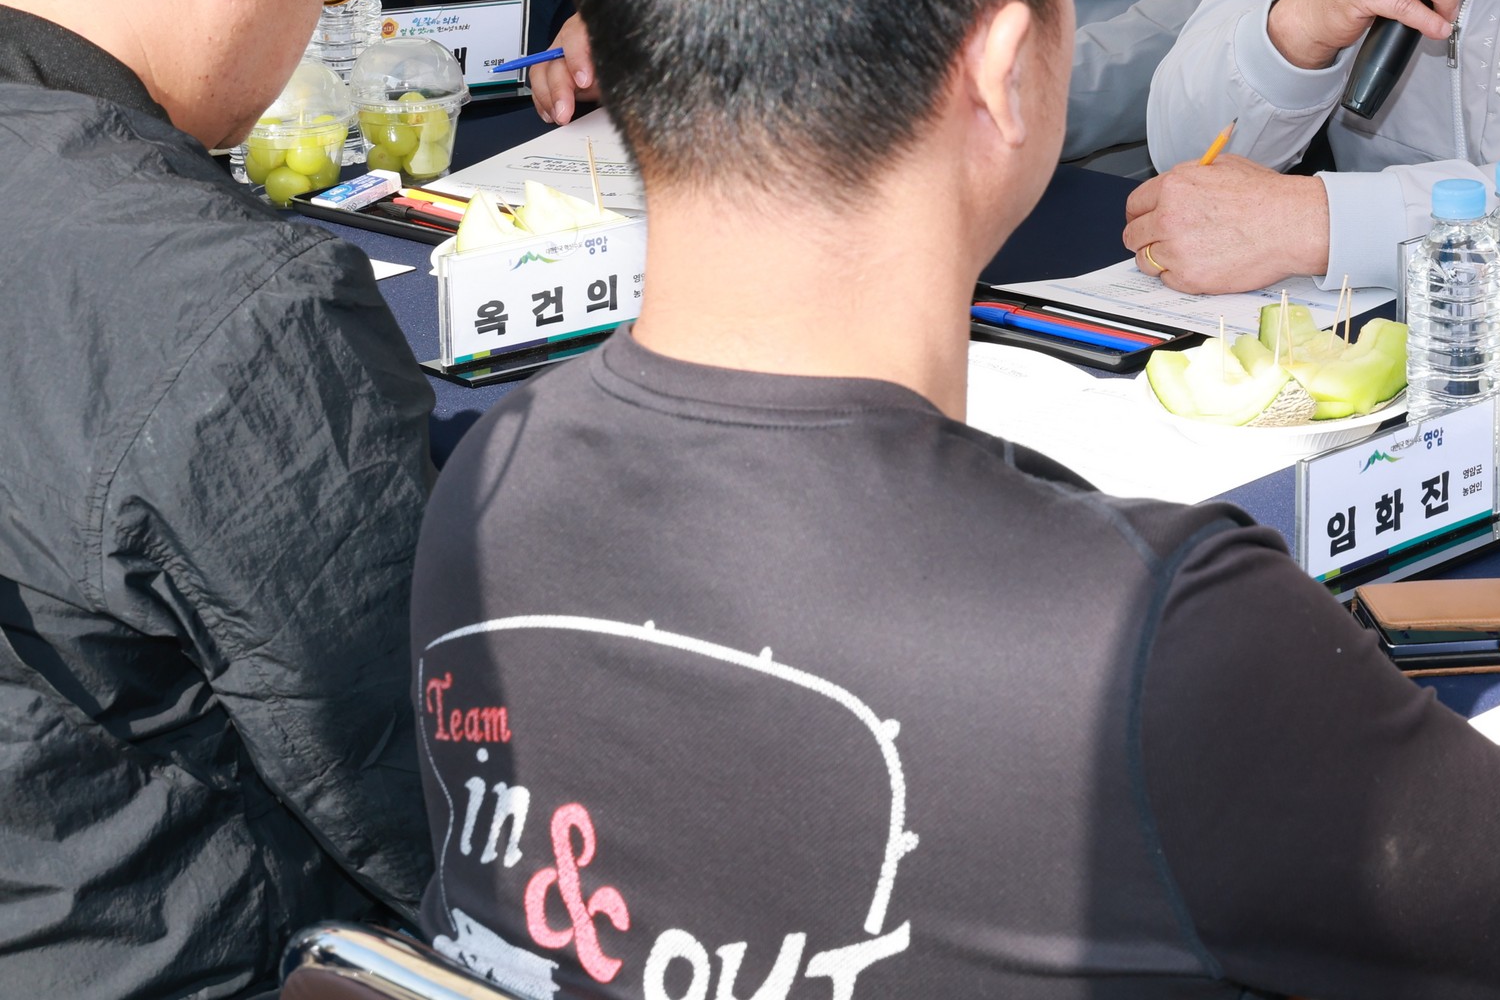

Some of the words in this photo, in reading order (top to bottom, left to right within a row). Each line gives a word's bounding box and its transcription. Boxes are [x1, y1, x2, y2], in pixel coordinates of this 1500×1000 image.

[584, 236, 608, 255] 영암
[1423, 427, 1444, 450] 영암
[1462, 464, 1483, 479] 영암군
[1462, 481, 1483, 497] 농업인
[426, 671, 512, 744] Team
[460, 747, 531, 869] in
[523, 802, 630, 984] &
